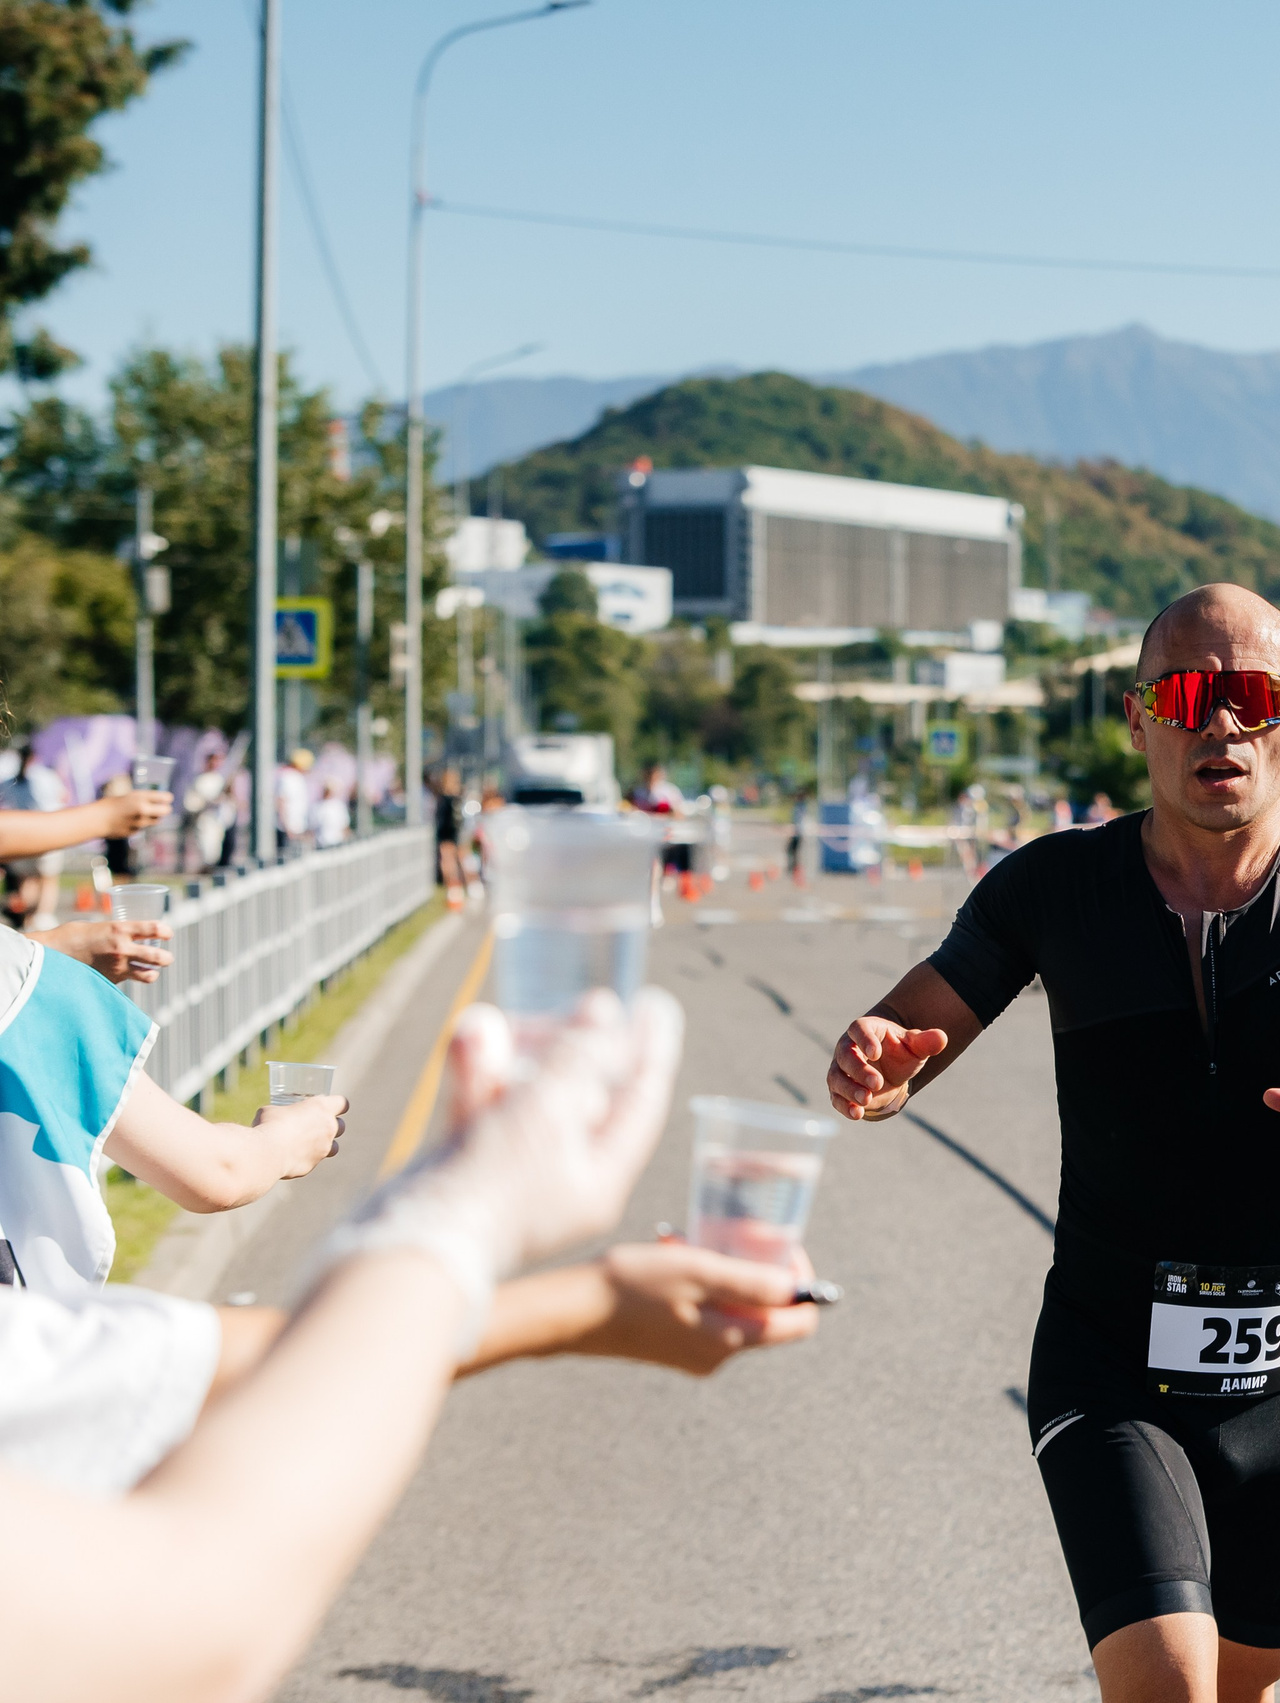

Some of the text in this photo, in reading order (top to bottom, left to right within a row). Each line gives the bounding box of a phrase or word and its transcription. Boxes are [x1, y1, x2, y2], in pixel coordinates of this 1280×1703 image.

[1167, 1274, 1182, 1283] IRON
[1166, 1282, 1187, 1294] STAR
[1200, 1282, 1210, 1291] 10
[1211, 1284, 1226, 1292] лет
[1220, 1375, 1268, 1392] ДАМИР
